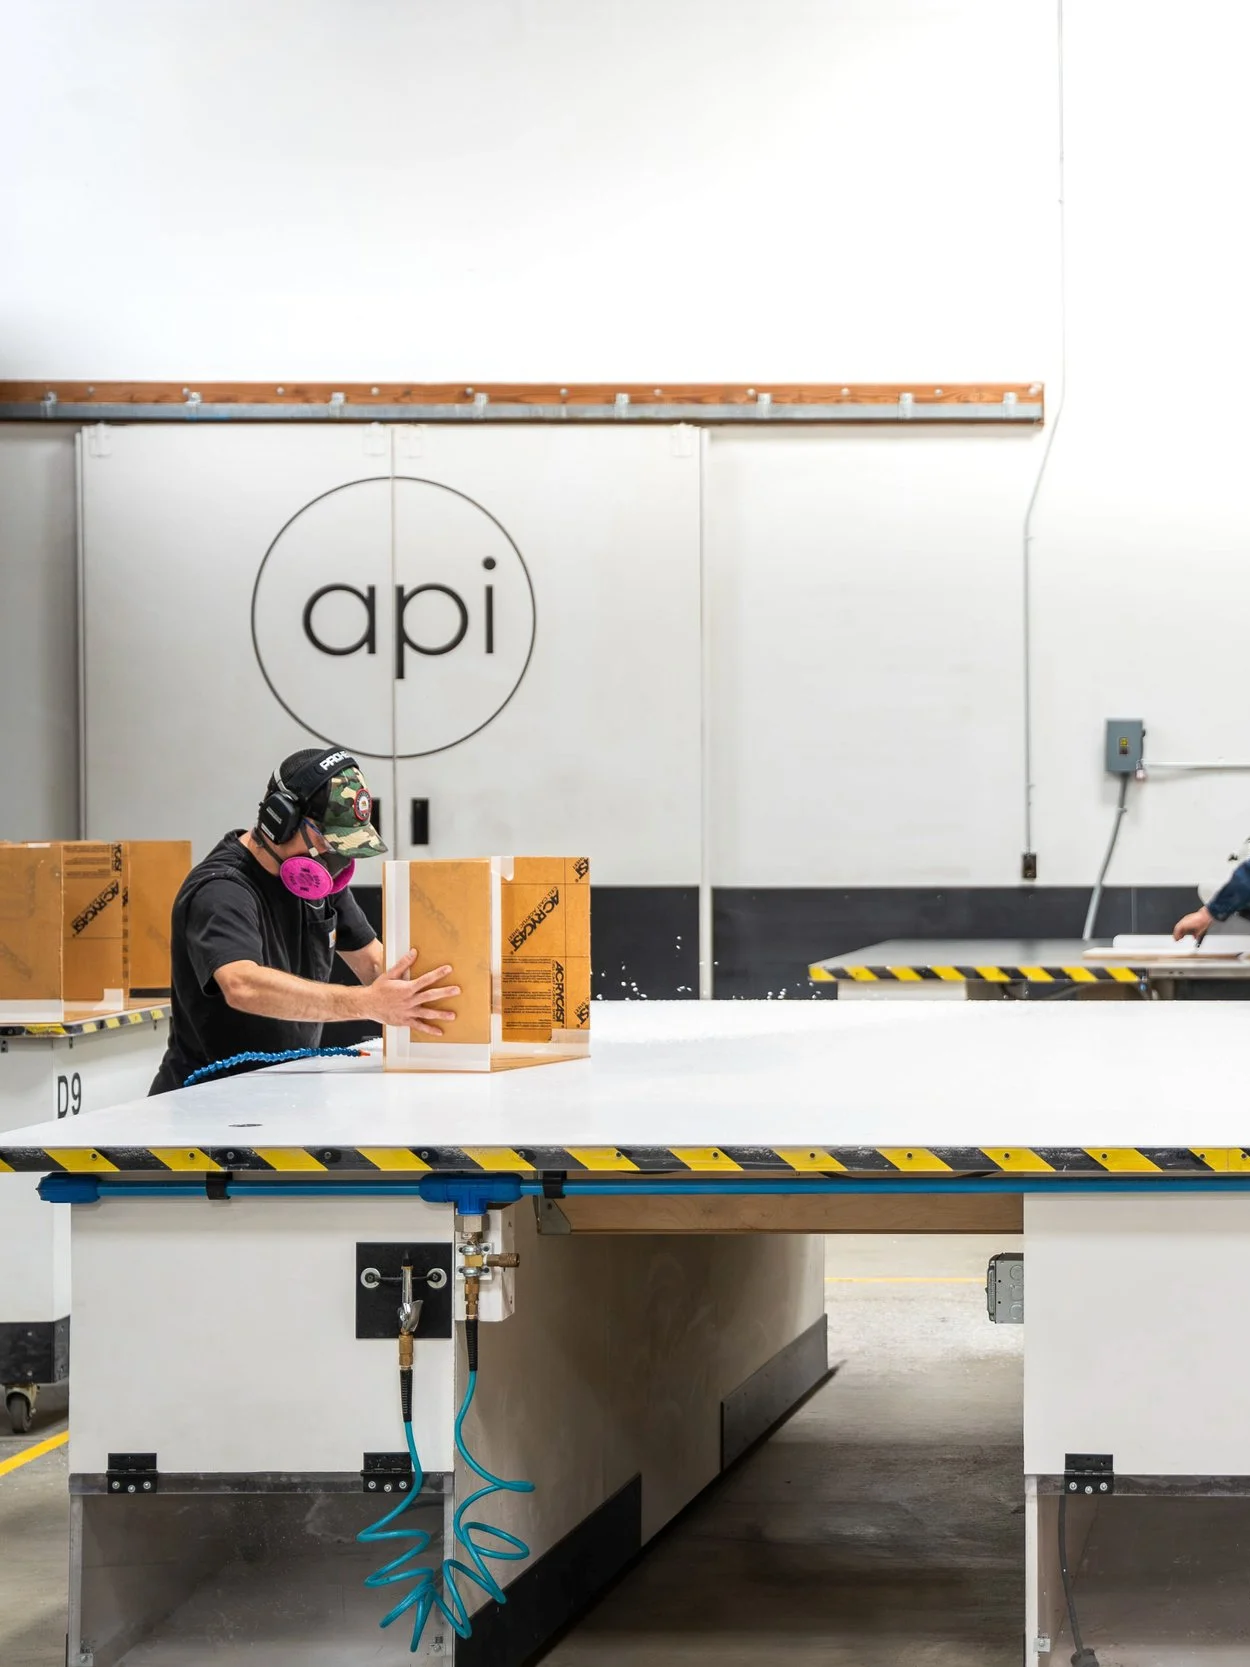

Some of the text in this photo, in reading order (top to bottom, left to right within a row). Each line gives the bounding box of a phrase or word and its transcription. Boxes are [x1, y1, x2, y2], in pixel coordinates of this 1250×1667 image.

[302, 555, 497, 681] api
[72, 879, 119, 935] ACRYCAST
[510, 888, 559, 952] ACRYCAST
[555, 960, 565, 1024] ACRYCAST
[57, 1072, 82, 1119] D9
